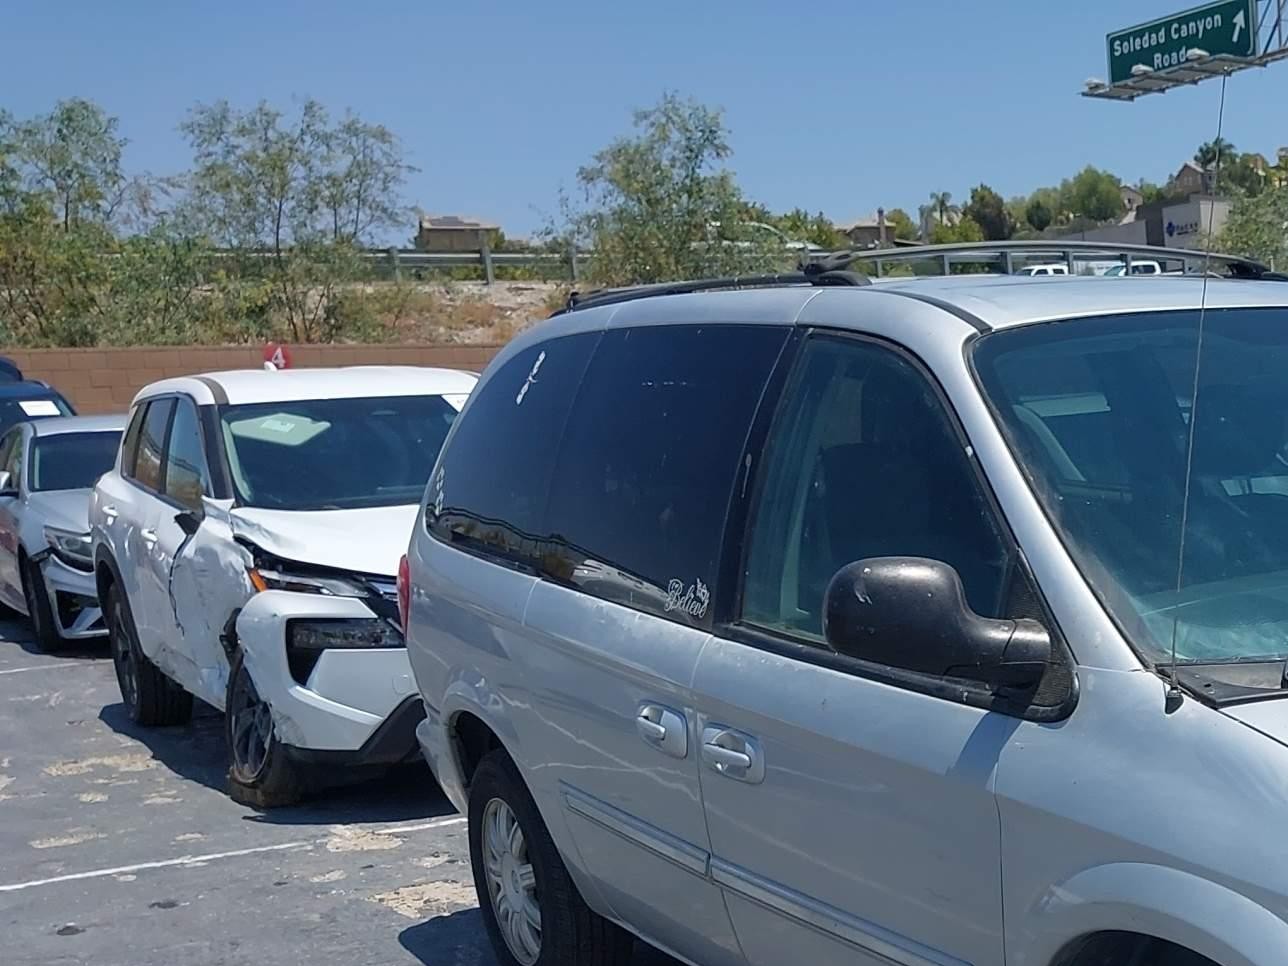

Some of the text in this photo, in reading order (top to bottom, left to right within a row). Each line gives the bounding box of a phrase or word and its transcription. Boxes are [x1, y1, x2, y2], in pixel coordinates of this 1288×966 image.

[1113, 14, 1222, 56] Soledad Canyon
[1153, 46, 1187, 69] Road
[271, 346, 286, 369] 4
